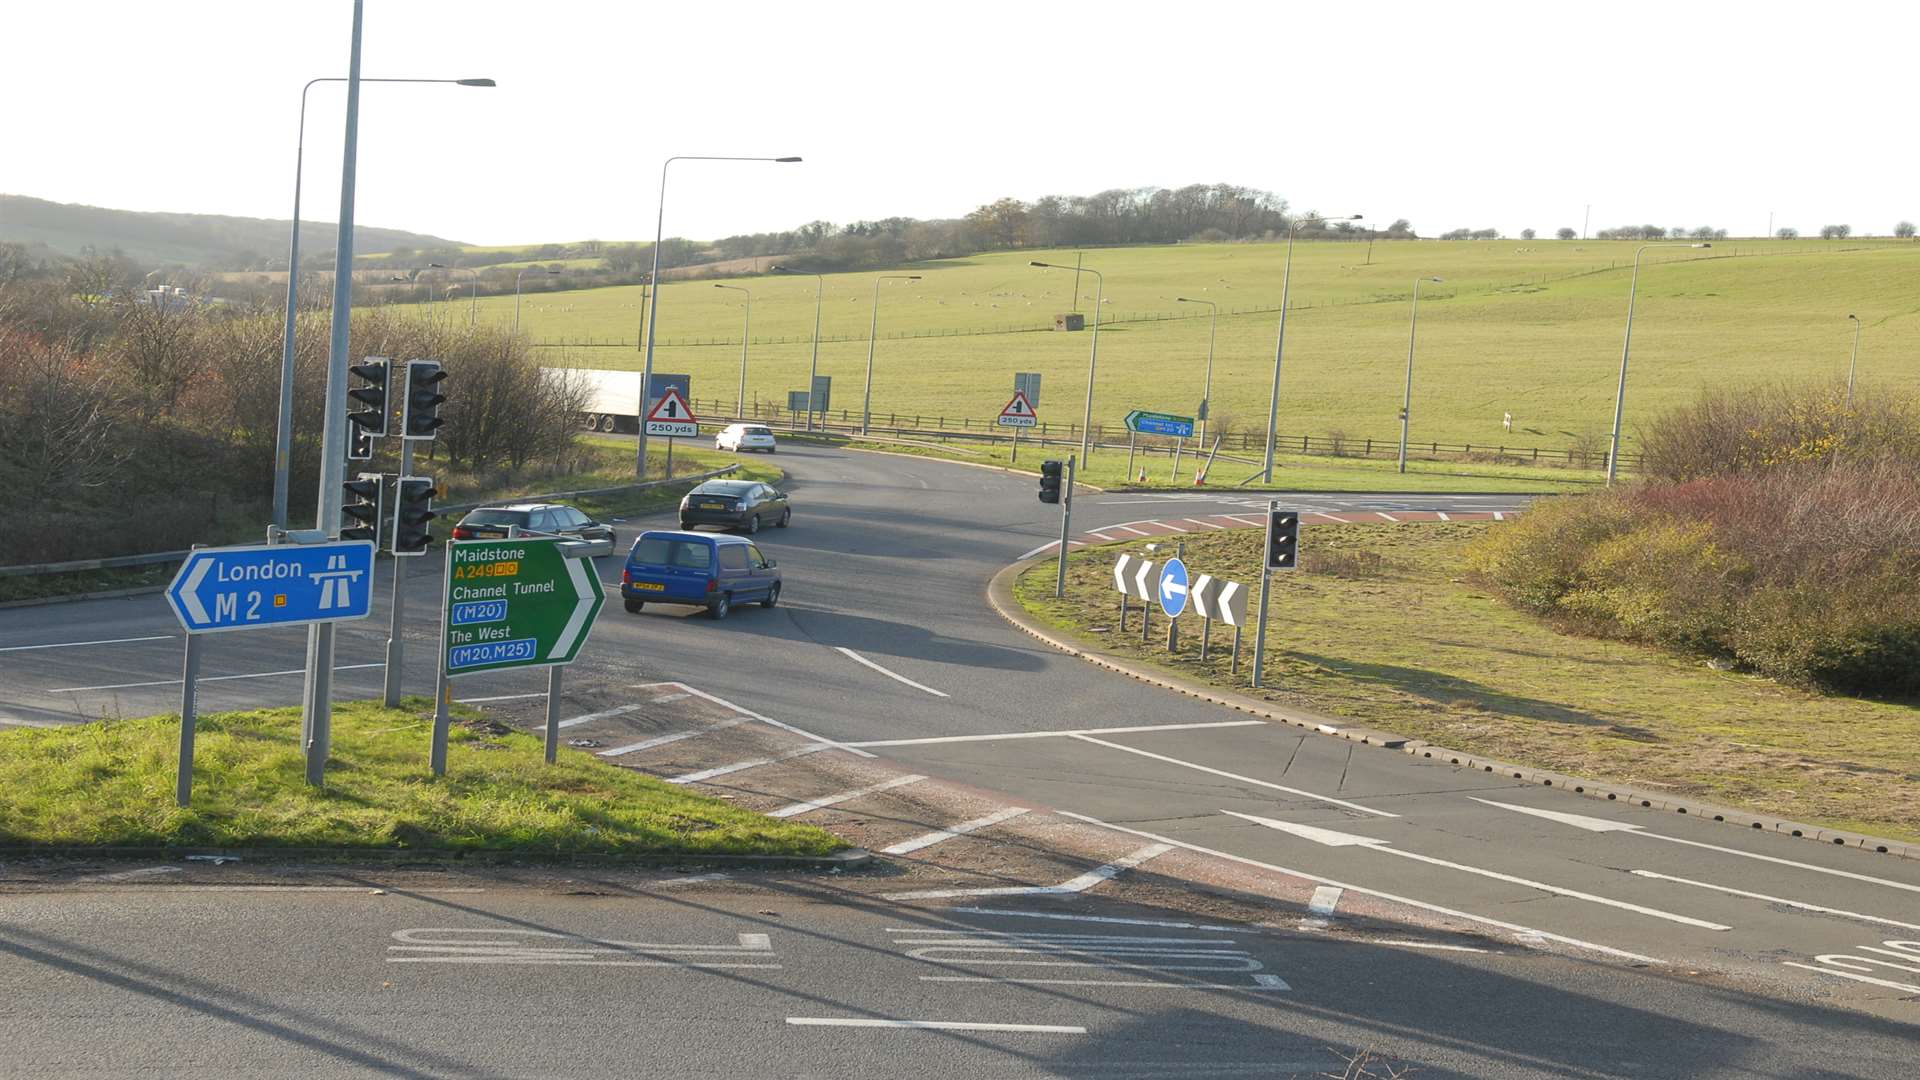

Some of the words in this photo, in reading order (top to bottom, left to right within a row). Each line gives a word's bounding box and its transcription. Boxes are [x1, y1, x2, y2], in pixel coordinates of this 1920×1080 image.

[650, 423, 672, 433] 250
[674, 424, 692, 434] yds
[455, 548, 525, 563] Maidstone
[217, 559, 302, 583] London
[453, 584, 507, 600] Channel
[513, 580, 555, 595] Tunnel
[456, 603, 503, 622] (M20)
[450, 630, 472, 644] The
[478, 626, 511, 640] West
